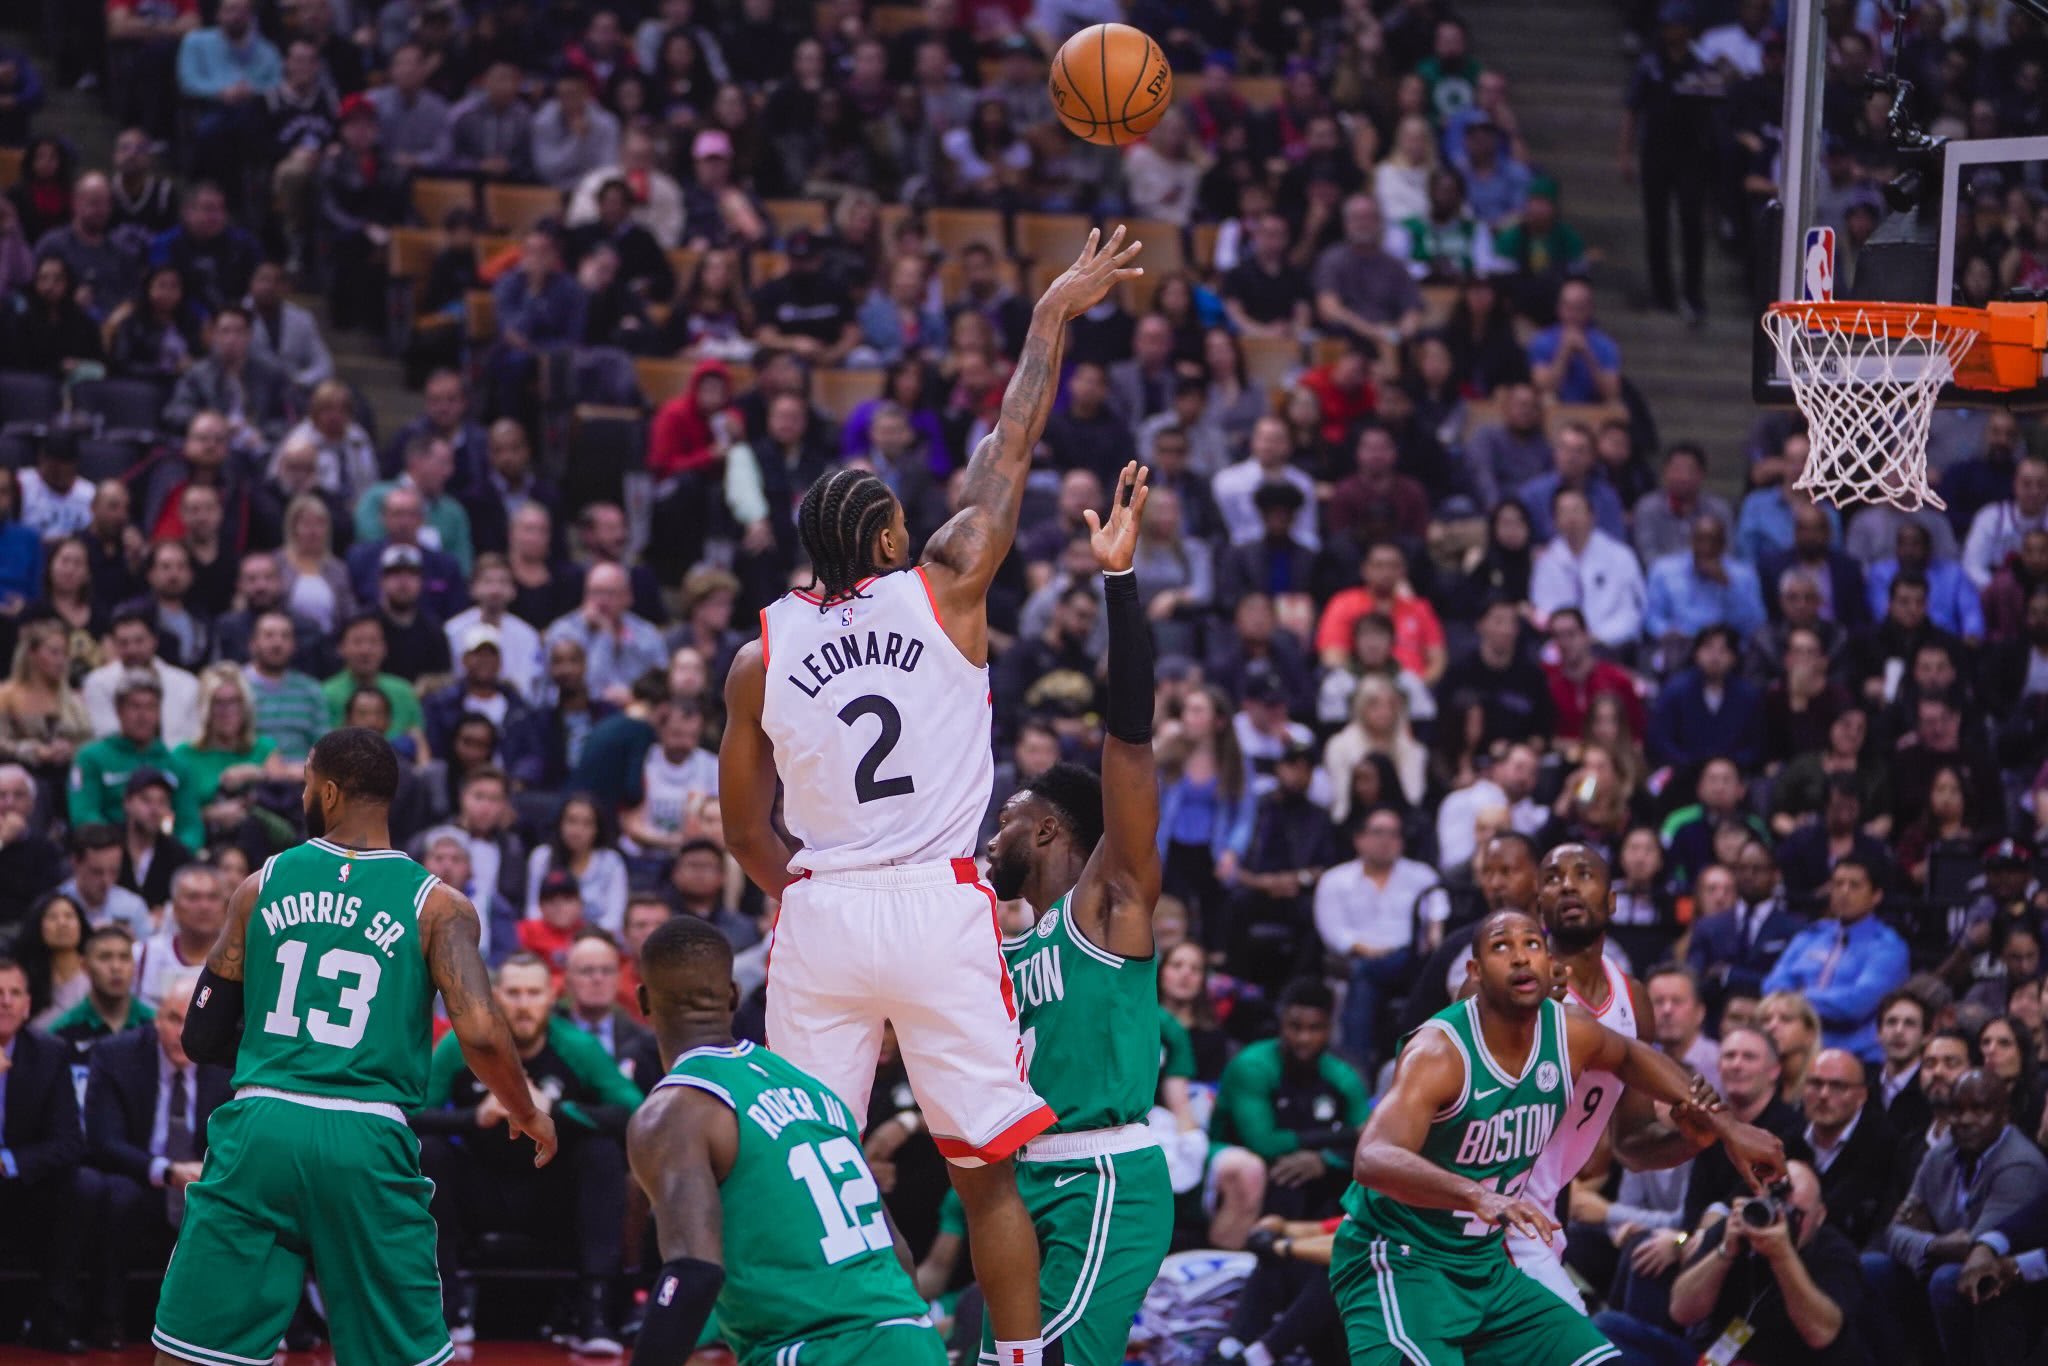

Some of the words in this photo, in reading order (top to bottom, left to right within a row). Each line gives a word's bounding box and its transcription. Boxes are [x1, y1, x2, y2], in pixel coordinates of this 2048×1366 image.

[788, 631, 925, 699] LEONARD
[837, 694, 915, 804] 2
[261, 891, 362, 936] MORRIS
[364, 911, 405, 959] SR.
[264, 939, 382, 1049] 13
[1010, 945, 1065, 1013] TON
[819, 1091, 849, 1132] III
[1455, 1103, 1557, 1166] BOSTON
[1576, 1086, 1604, 1129] 9
[787, 1136, 894, 1265] 12
